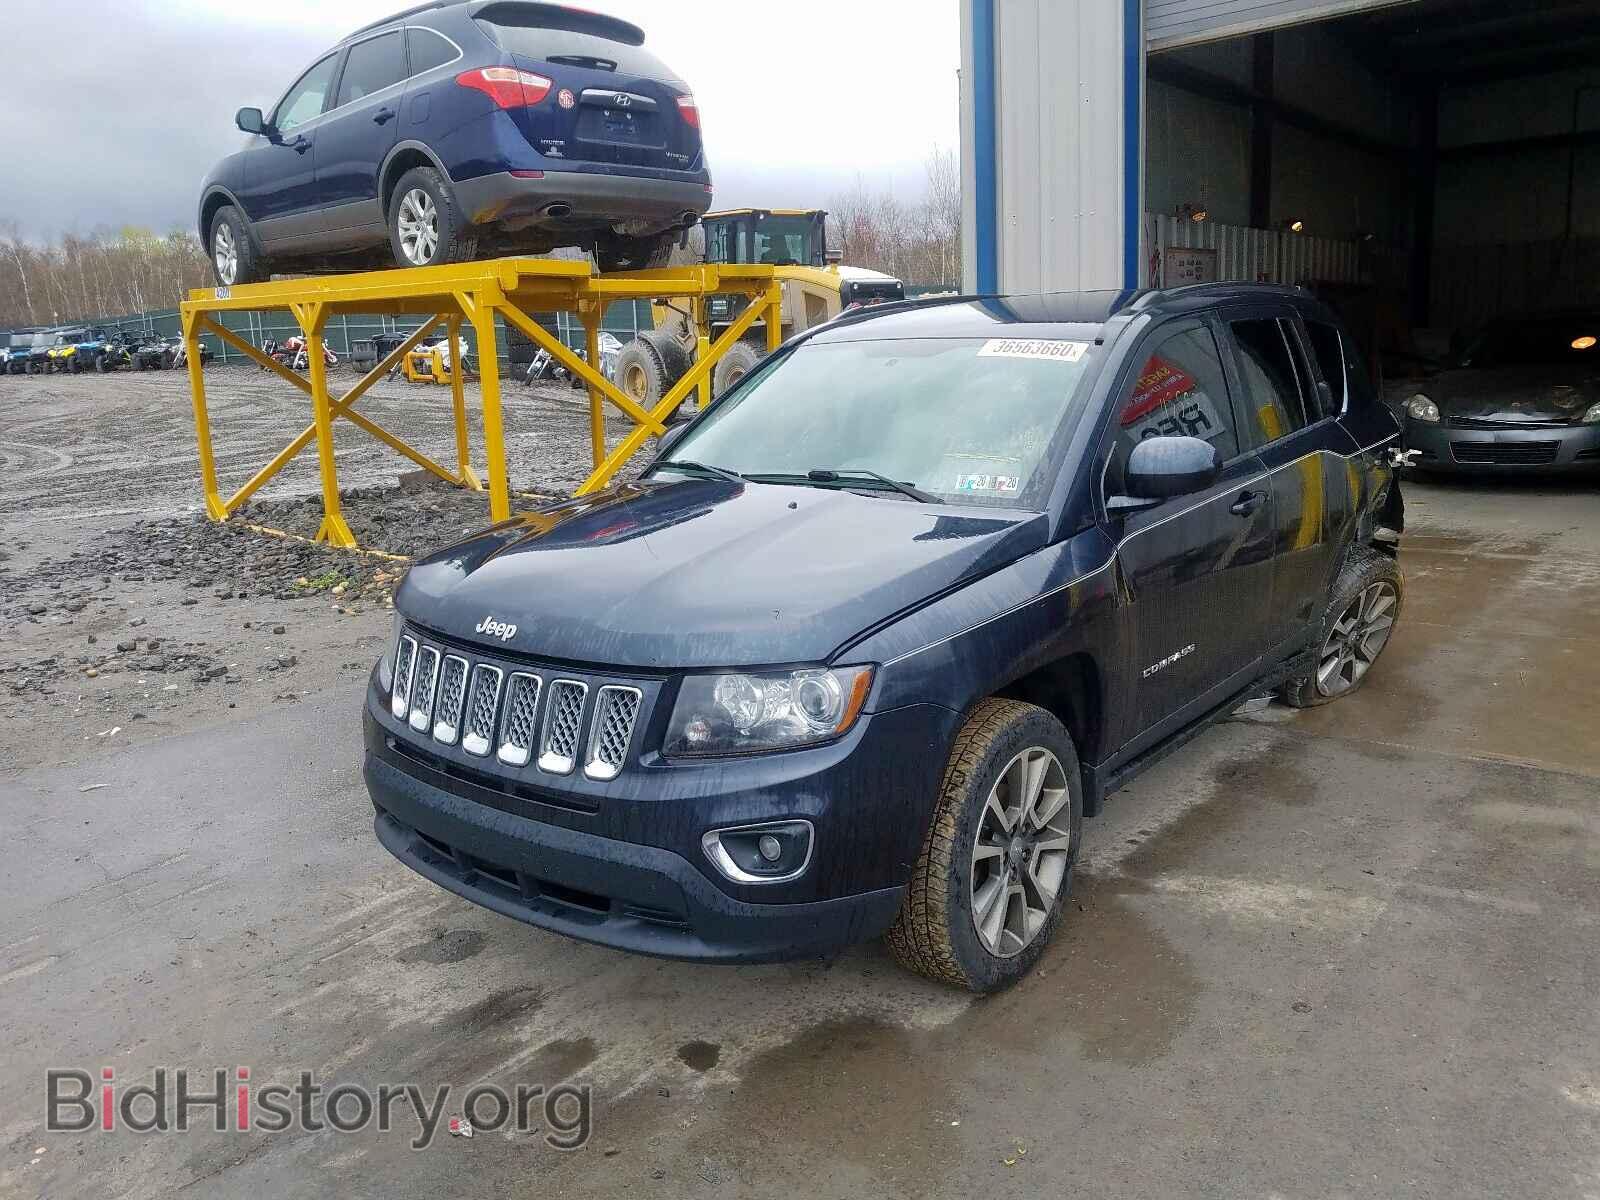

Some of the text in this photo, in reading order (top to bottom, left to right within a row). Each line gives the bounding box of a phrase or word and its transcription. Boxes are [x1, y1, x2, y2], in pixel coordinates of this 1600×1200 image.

[993, 340, 1073, 356] 36563660
[475, 615, 517, 642] Jeep
[1143, 643, 1196, 679] COMPASS
